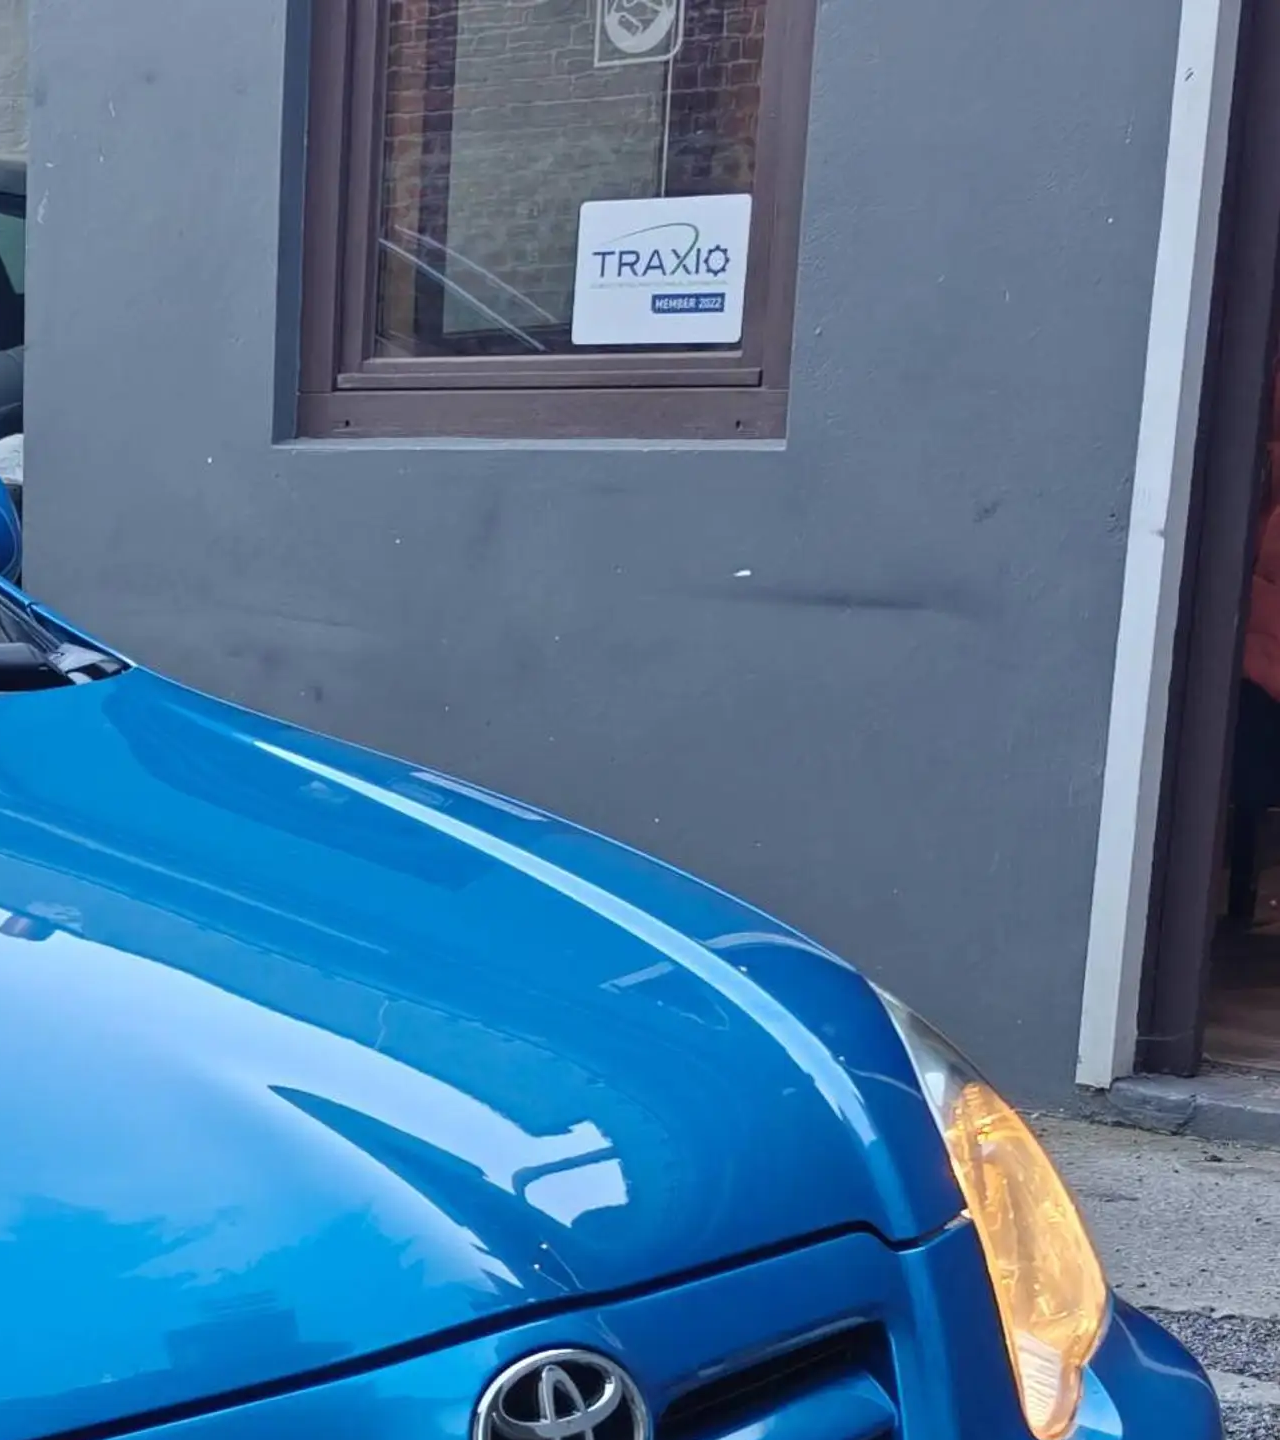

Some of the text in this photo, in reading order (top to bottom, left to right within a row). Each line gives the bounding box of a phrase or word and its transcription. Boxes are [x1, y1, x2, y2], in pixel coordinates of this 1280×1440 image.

[592, 245, 730, 278] TRAXIO
[654, 297, 722, 310] MEMBER 2022
